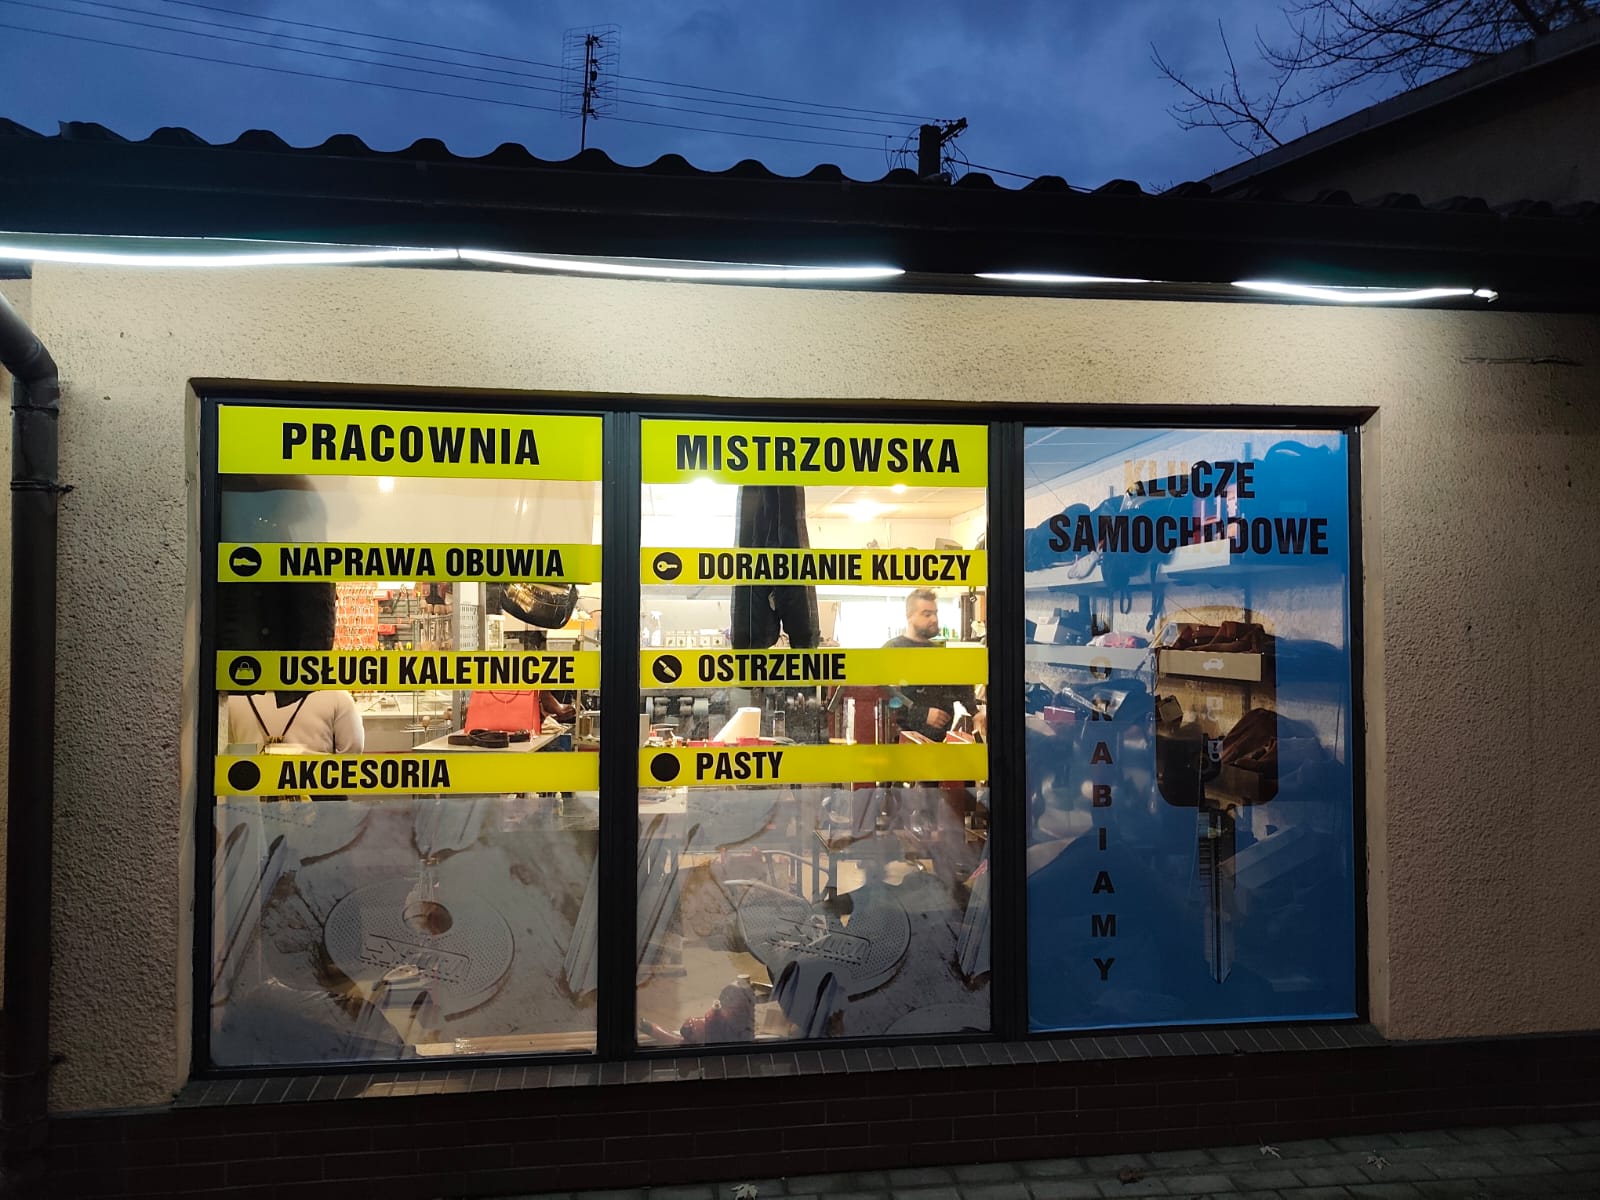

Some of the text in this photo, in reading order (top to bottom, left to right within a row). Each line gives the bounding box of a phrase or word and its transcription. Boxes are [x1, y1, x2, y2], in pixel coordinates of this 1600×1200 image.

[283, 422, 540, 465] PRACOWNIA
[676, 435, 960, 473] MISTRZOWSKA
[1124, 460, 1255, 498] KLUCZE
[1049, 513, 1329, 555] SAMOCHODOWE
[280, 547, 564, 577] NAPRAWA OBUWIA
[699, 553, 971, 581] DORABIANIE KLUCZY
[279, 655, 576, 685] USŁUGI KALETNICZE
[698, 653, 847, 682] OSTRZENIE
[277, 759, 451, 790] AKCESORIA
[696, 751, 784, 780] PASTY
